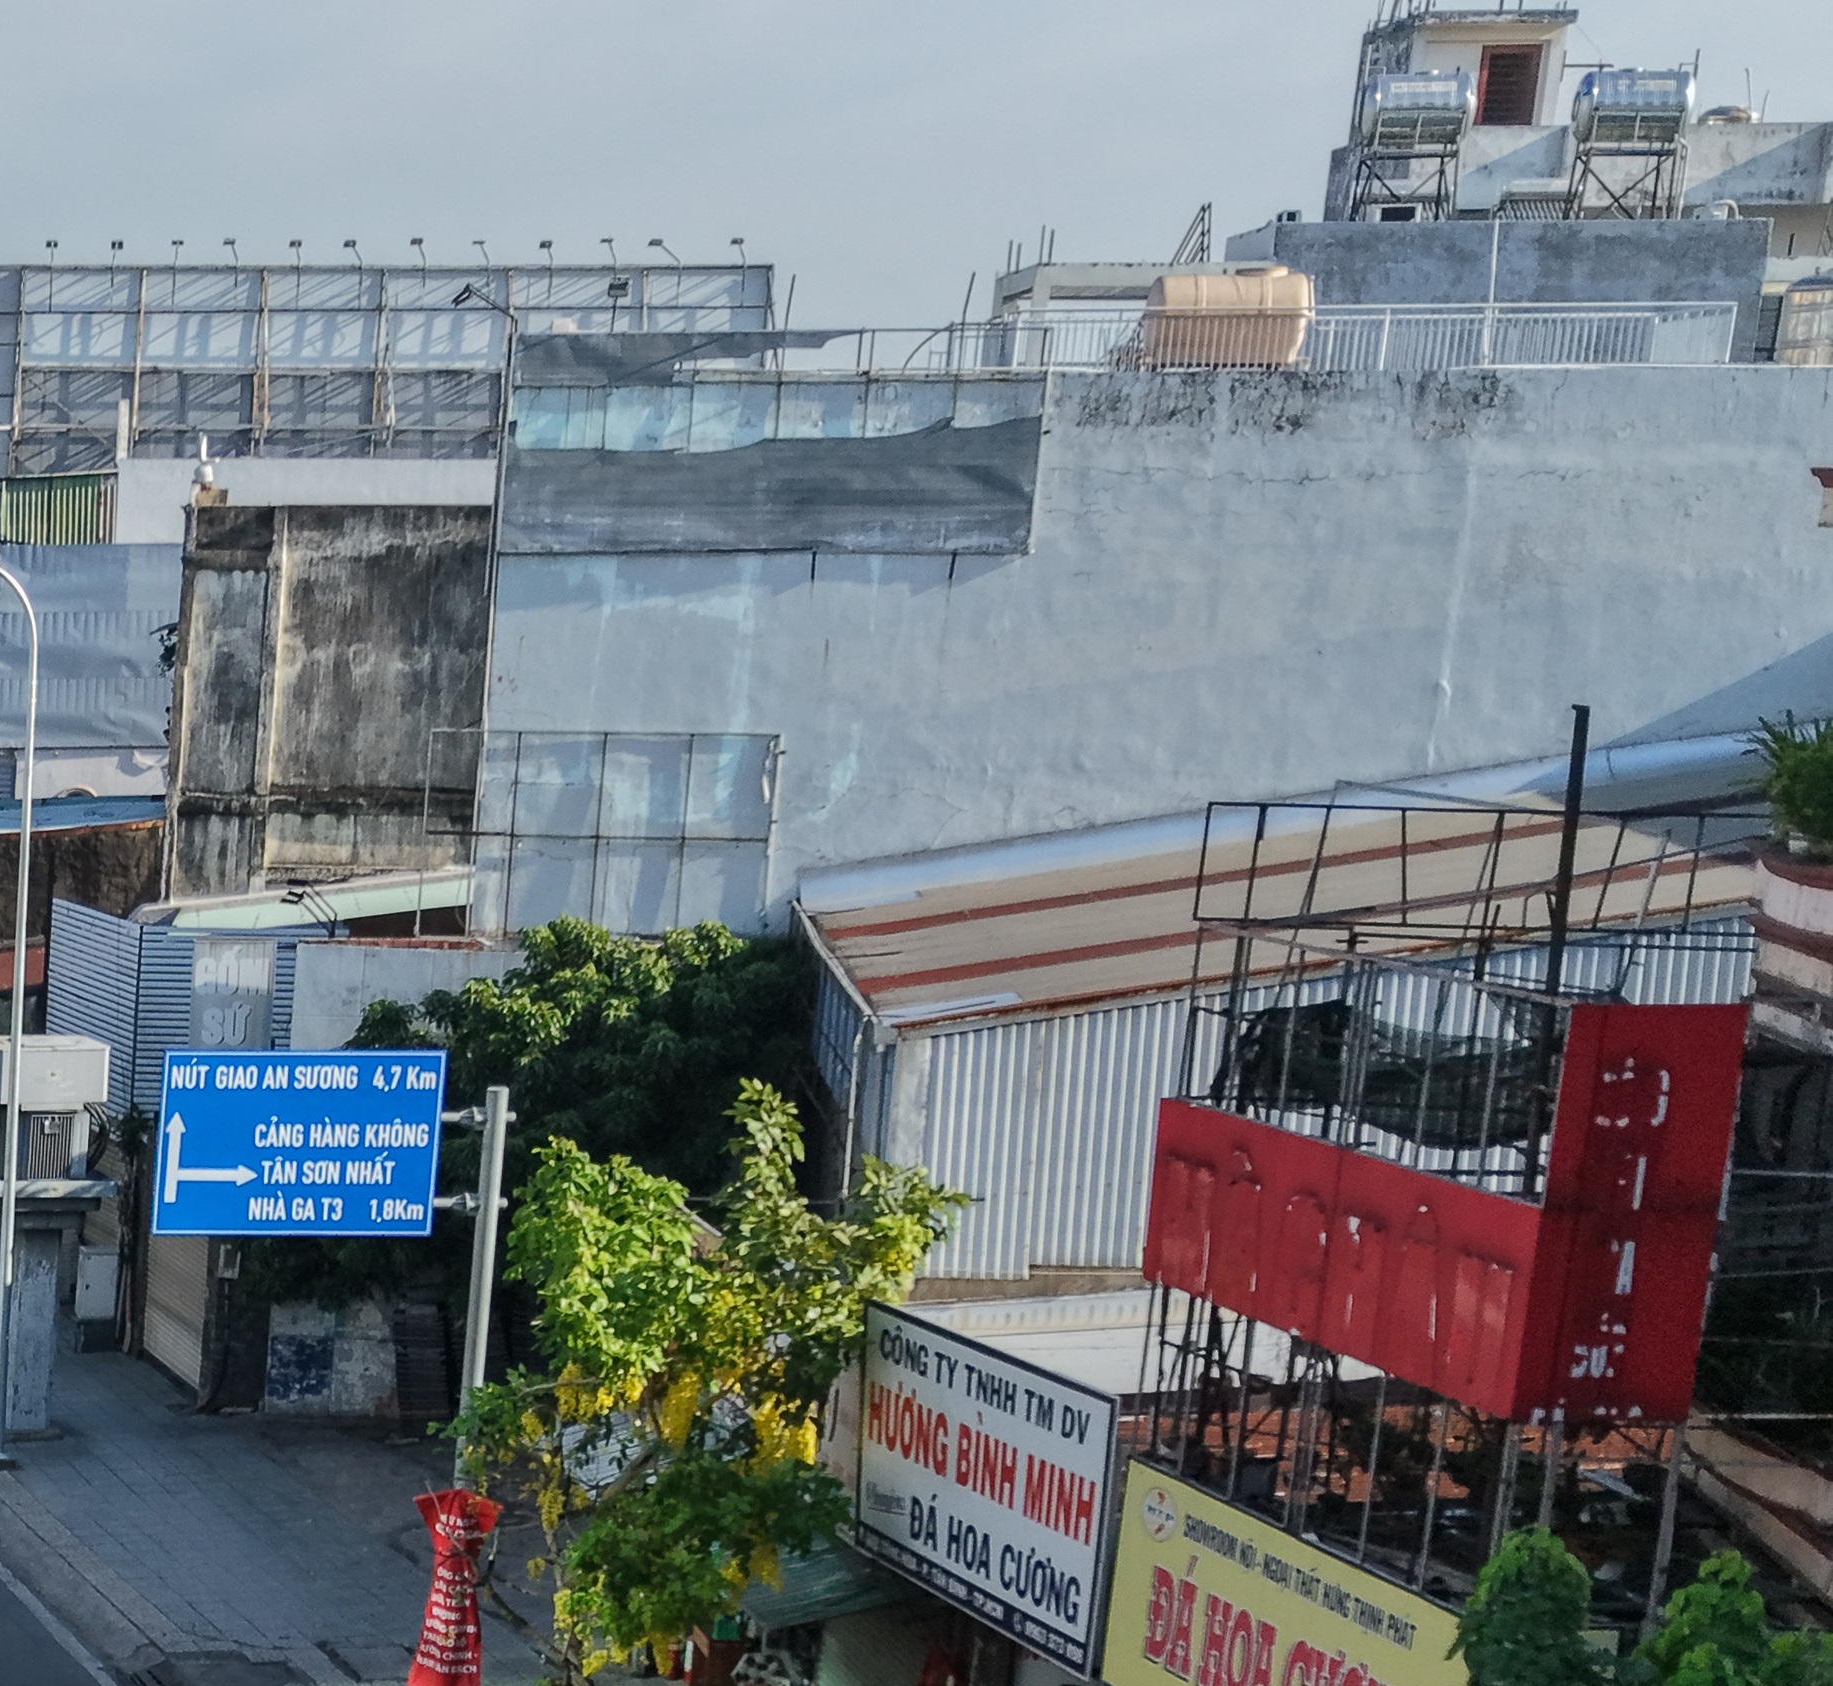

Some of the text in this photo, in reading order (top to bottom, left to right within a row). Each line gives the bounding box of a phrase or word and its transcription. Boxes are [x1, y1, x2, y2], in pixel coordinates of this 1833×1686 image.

[195, 945, 271, 995] GỐM
[201, 1001, 253, 1046] SỨ
[171, 1058, 437, 1092] NÚT GIAO AN SƯƠNG 4,7 Km
[254, 1115, 429, 1149] CẢNG HÀNG KHÔNG
[261, 1151, 396, 1185] TÂN SƠN NHẤT
[248, 1190, 285, 1221] NHÀ
[291, 1197, 316, 1220] GA
[321, 1198, 343, 1221] T3
[880, 1325, 1091, 1445] CÔNG TY TNHH TM DV
[868, 1380, 1096, 1547] HƯƠNG BÌNH MINH
[910, 1494, 938, 1552] ĐÁ
[946, 1515, 991, 1580] HOA
[1000, 1544, 1081, 1626] CƯƠNG
[1144, 1554, 1200, 1682] ĐÁ
